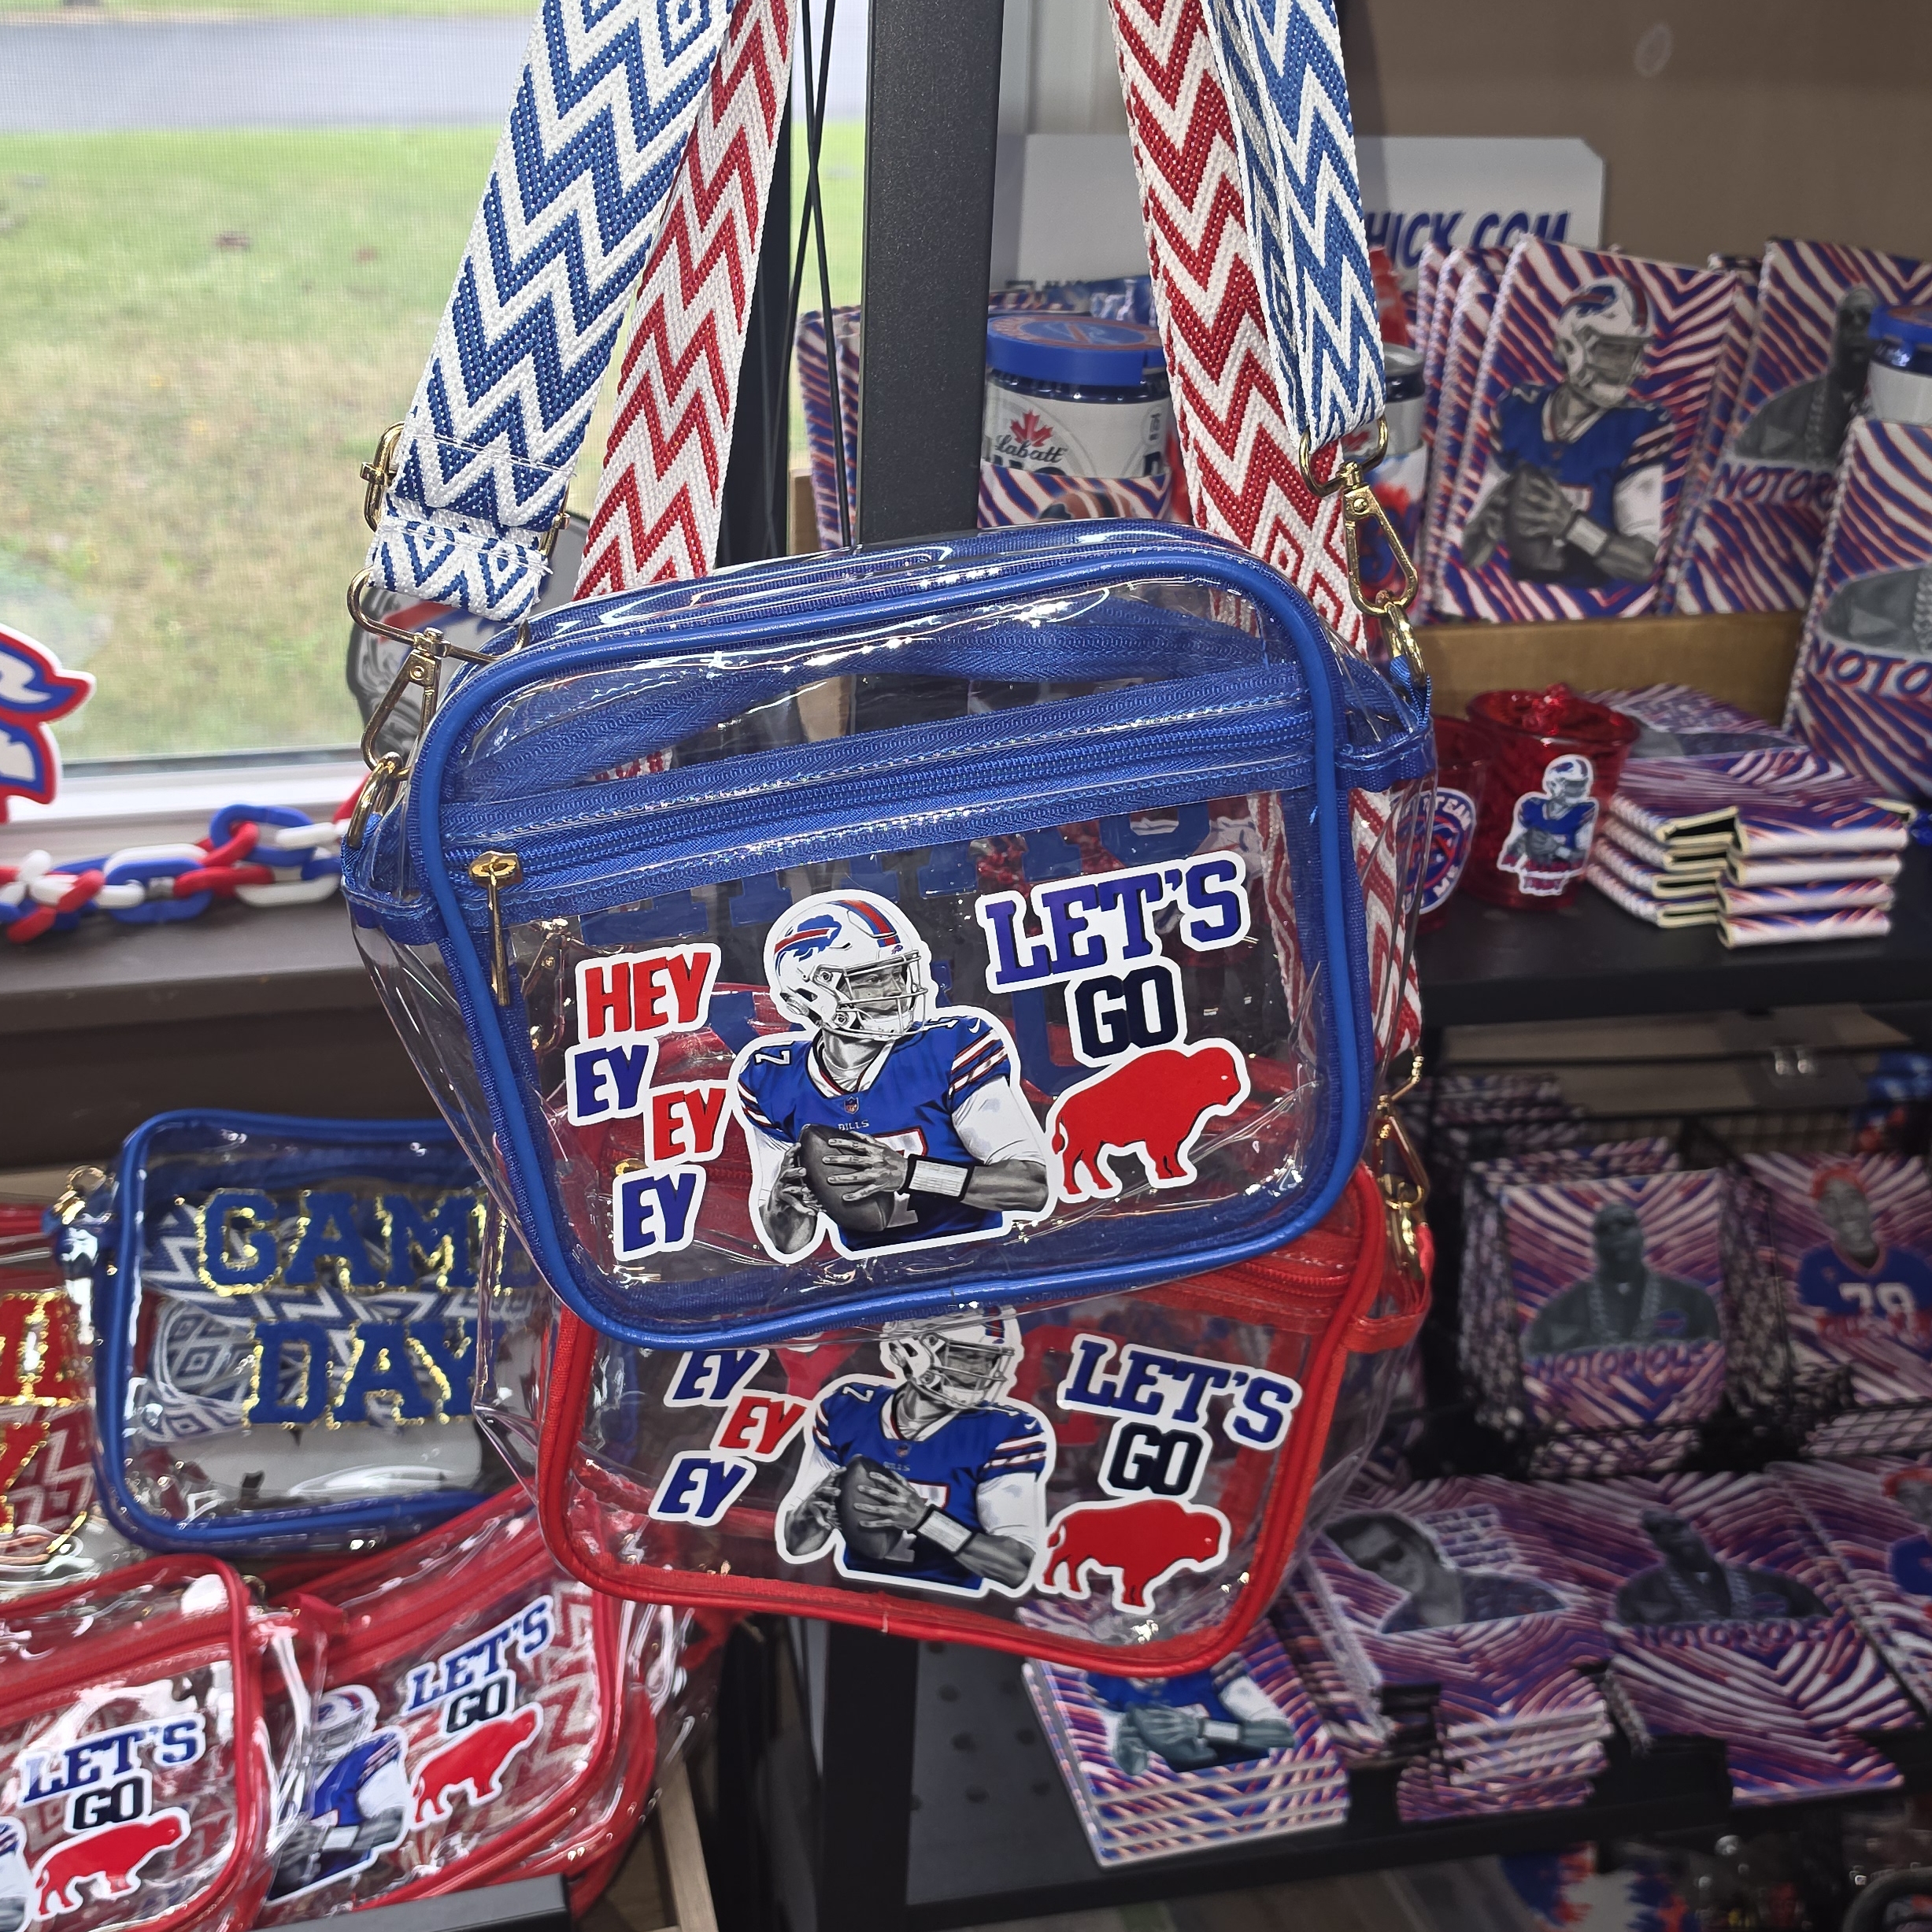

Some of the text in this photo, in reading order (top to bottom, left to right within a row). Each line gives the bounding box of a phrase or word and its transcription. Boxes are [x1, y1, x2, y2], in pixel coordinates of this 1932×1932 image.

[995, 435, 1068, 463] Labatt
[985, 858, 1242, 985] LET'S
[585, 952, 711, 1039] HEY
[1074, 965, 1179, 1059] GO
[574, 1045, 649, 1118] EY
[653, 1087, 726, 1161] EY
[622, 1173, 697, 1252] EY
[243, 1318, 508, 1428] DAY
[672, 1349, 761, 1400] EY
[1064, 1340, 1294, 1444] LET'S
[718, 1395, 807, 1454] EY
[1107, 1422, 1203, 1496] GO
[657, 1458, 747, 1518] EY
[407, 1602, 548, 1710] LET'S
[446, 1676, 509, 1733] GO
[24, 1719, 197, 1802] LET'S
[73, 1776, 143, 1830] GO
